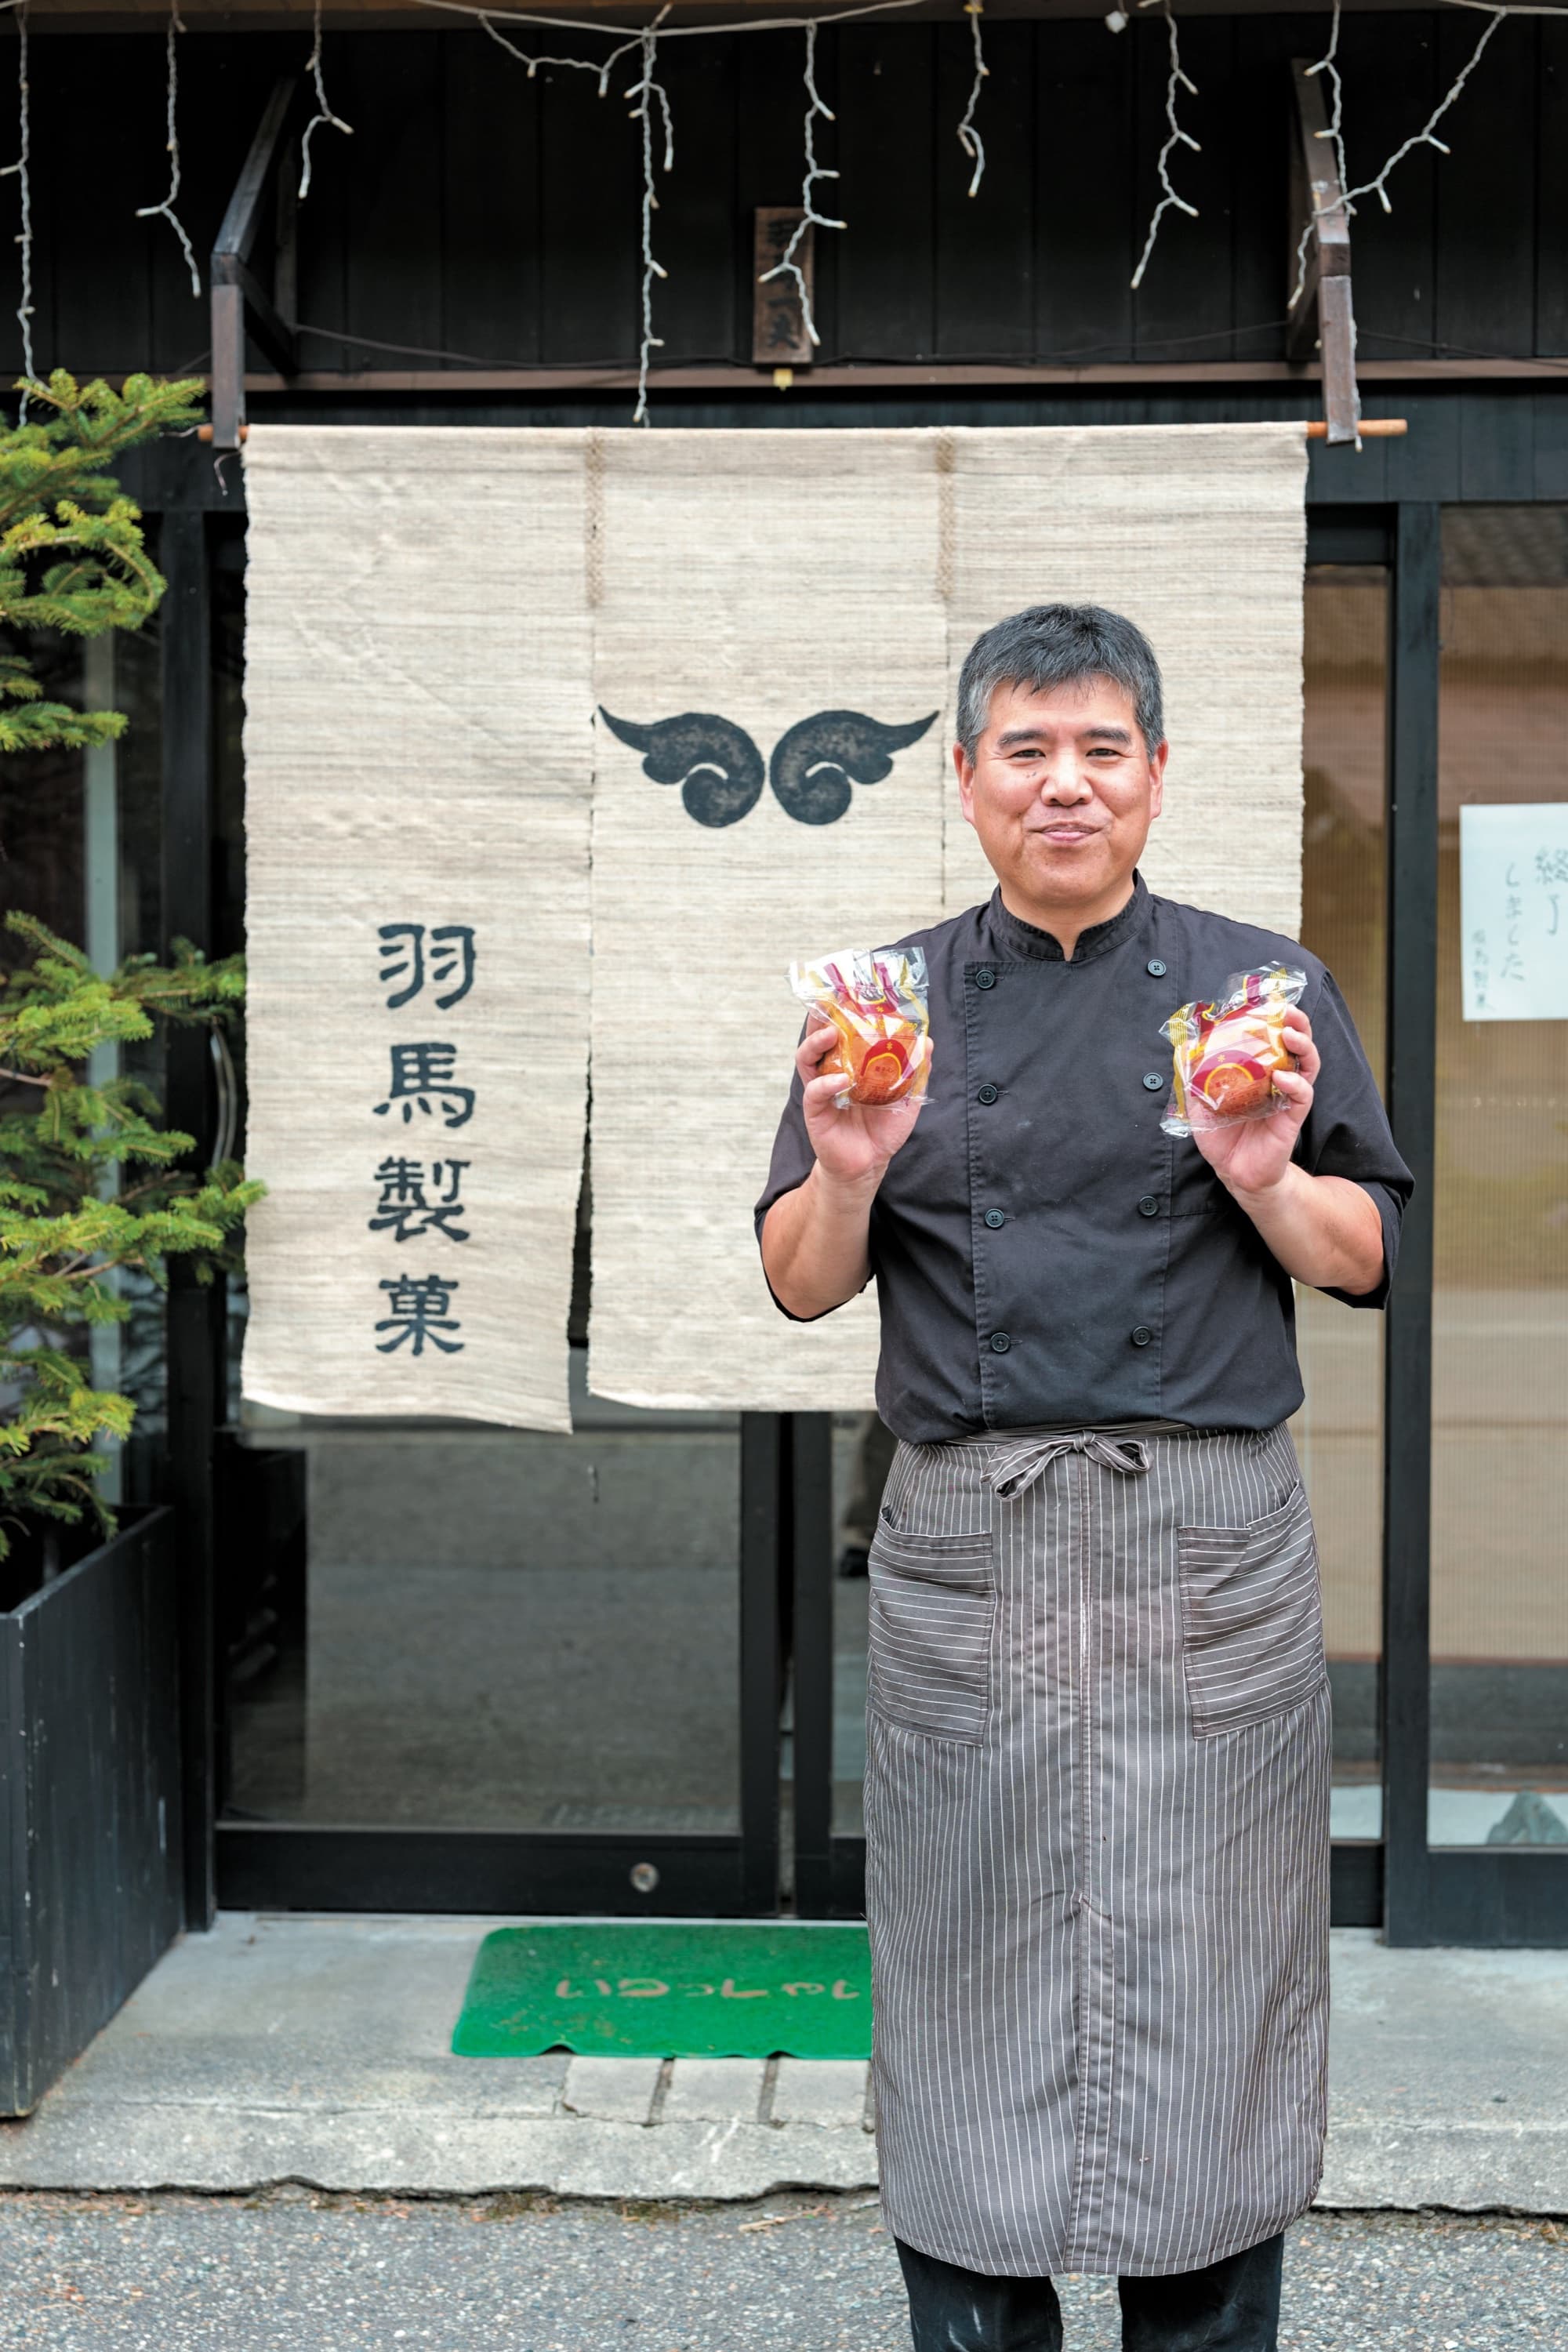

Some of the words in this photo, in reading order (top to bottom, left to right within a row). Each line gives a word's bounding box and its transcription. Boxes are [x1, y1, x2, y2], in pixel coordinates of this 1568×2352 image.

[1500, 862, 1526, 982] しました
[368, 923, 476, 1356] 羽馬製菓
